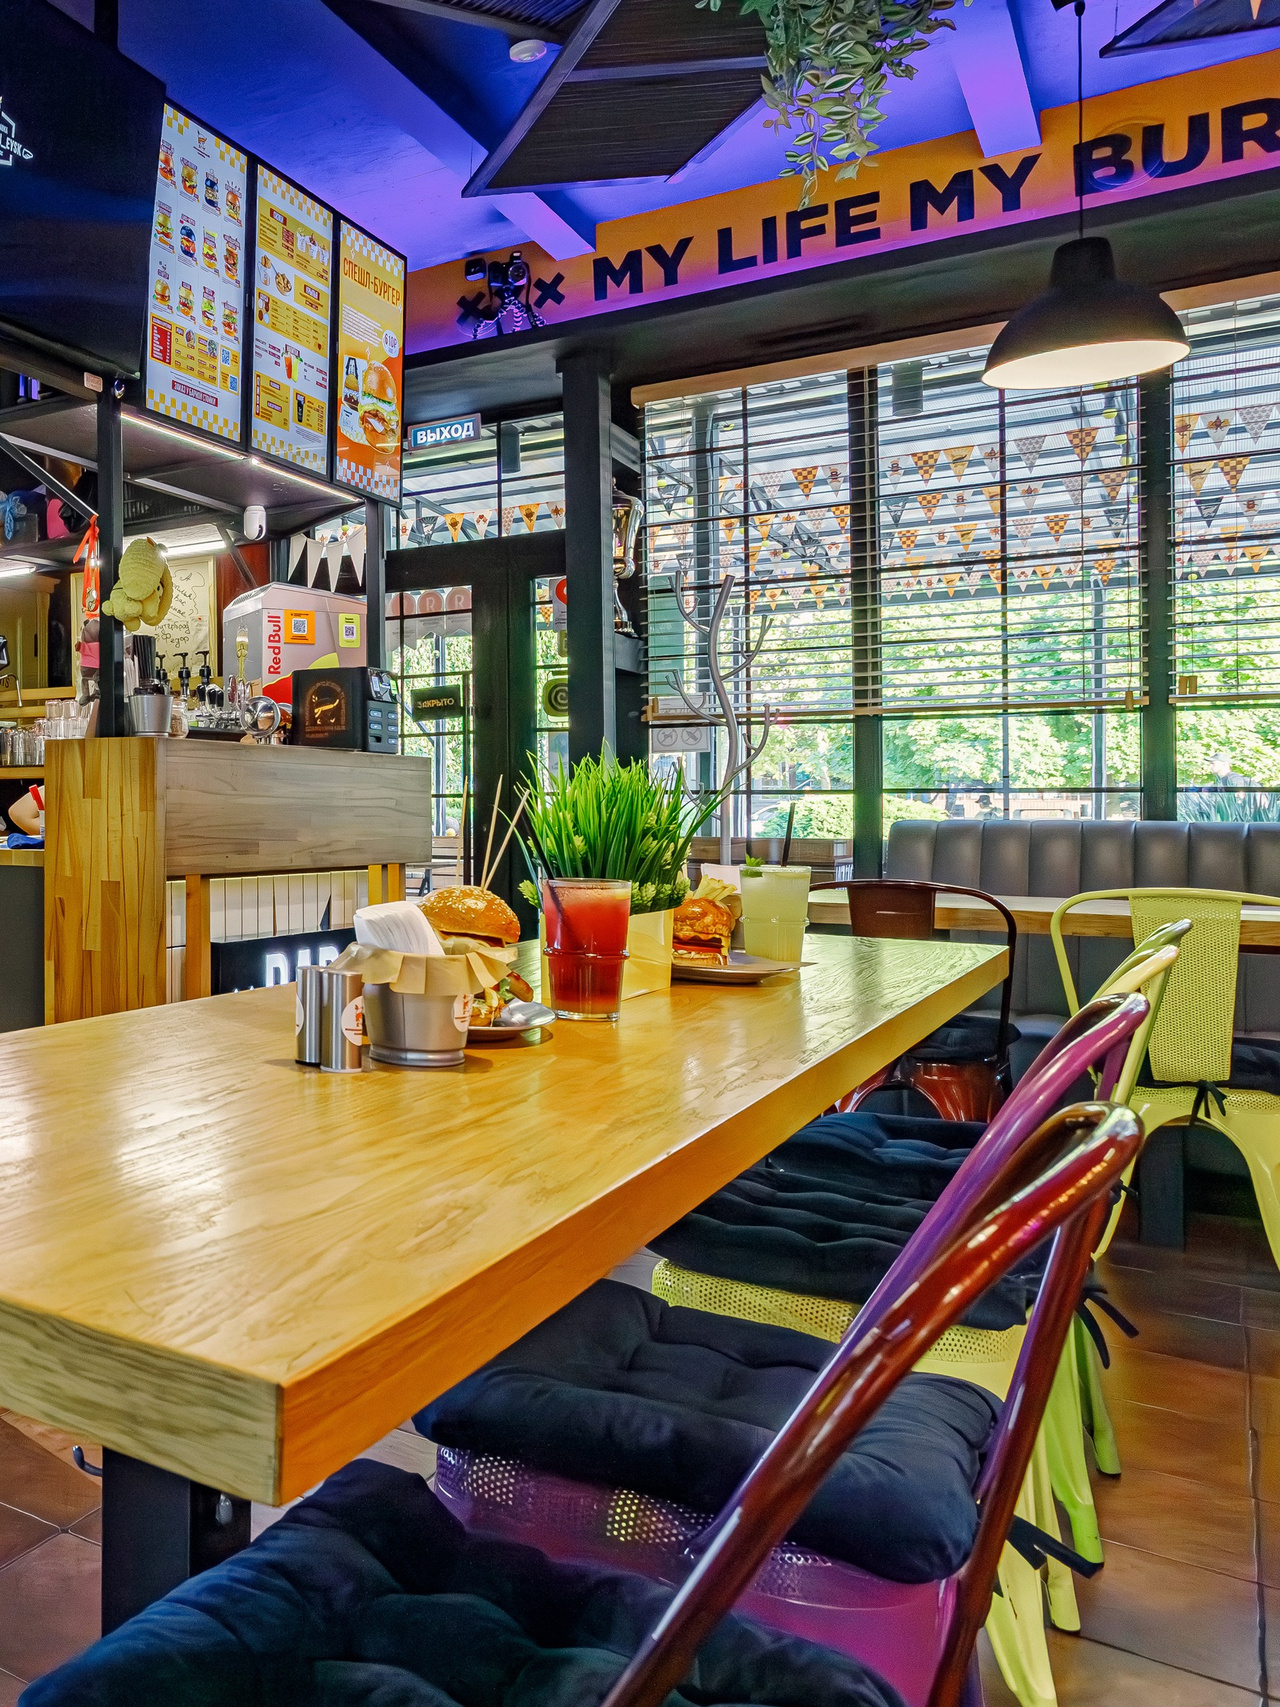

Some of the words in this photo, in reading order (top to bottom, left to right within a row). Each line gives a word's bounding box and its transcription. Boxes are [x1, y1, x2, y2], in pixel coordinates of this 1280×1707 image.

[592, 236, 694, 301] MY
[716, 191, 882, 275] LIFE
[909, 153, 1042, 232] MY
[343, 257, 401, 307] СПЕШЛ-БУРГЕР
[416, 422, 475, 444] ВЫХОД
[267, 615, 281, 643] Bull
[267, 646, 281, 675] Red
[417, 697, 455, 709] ЗАКРЫТО
